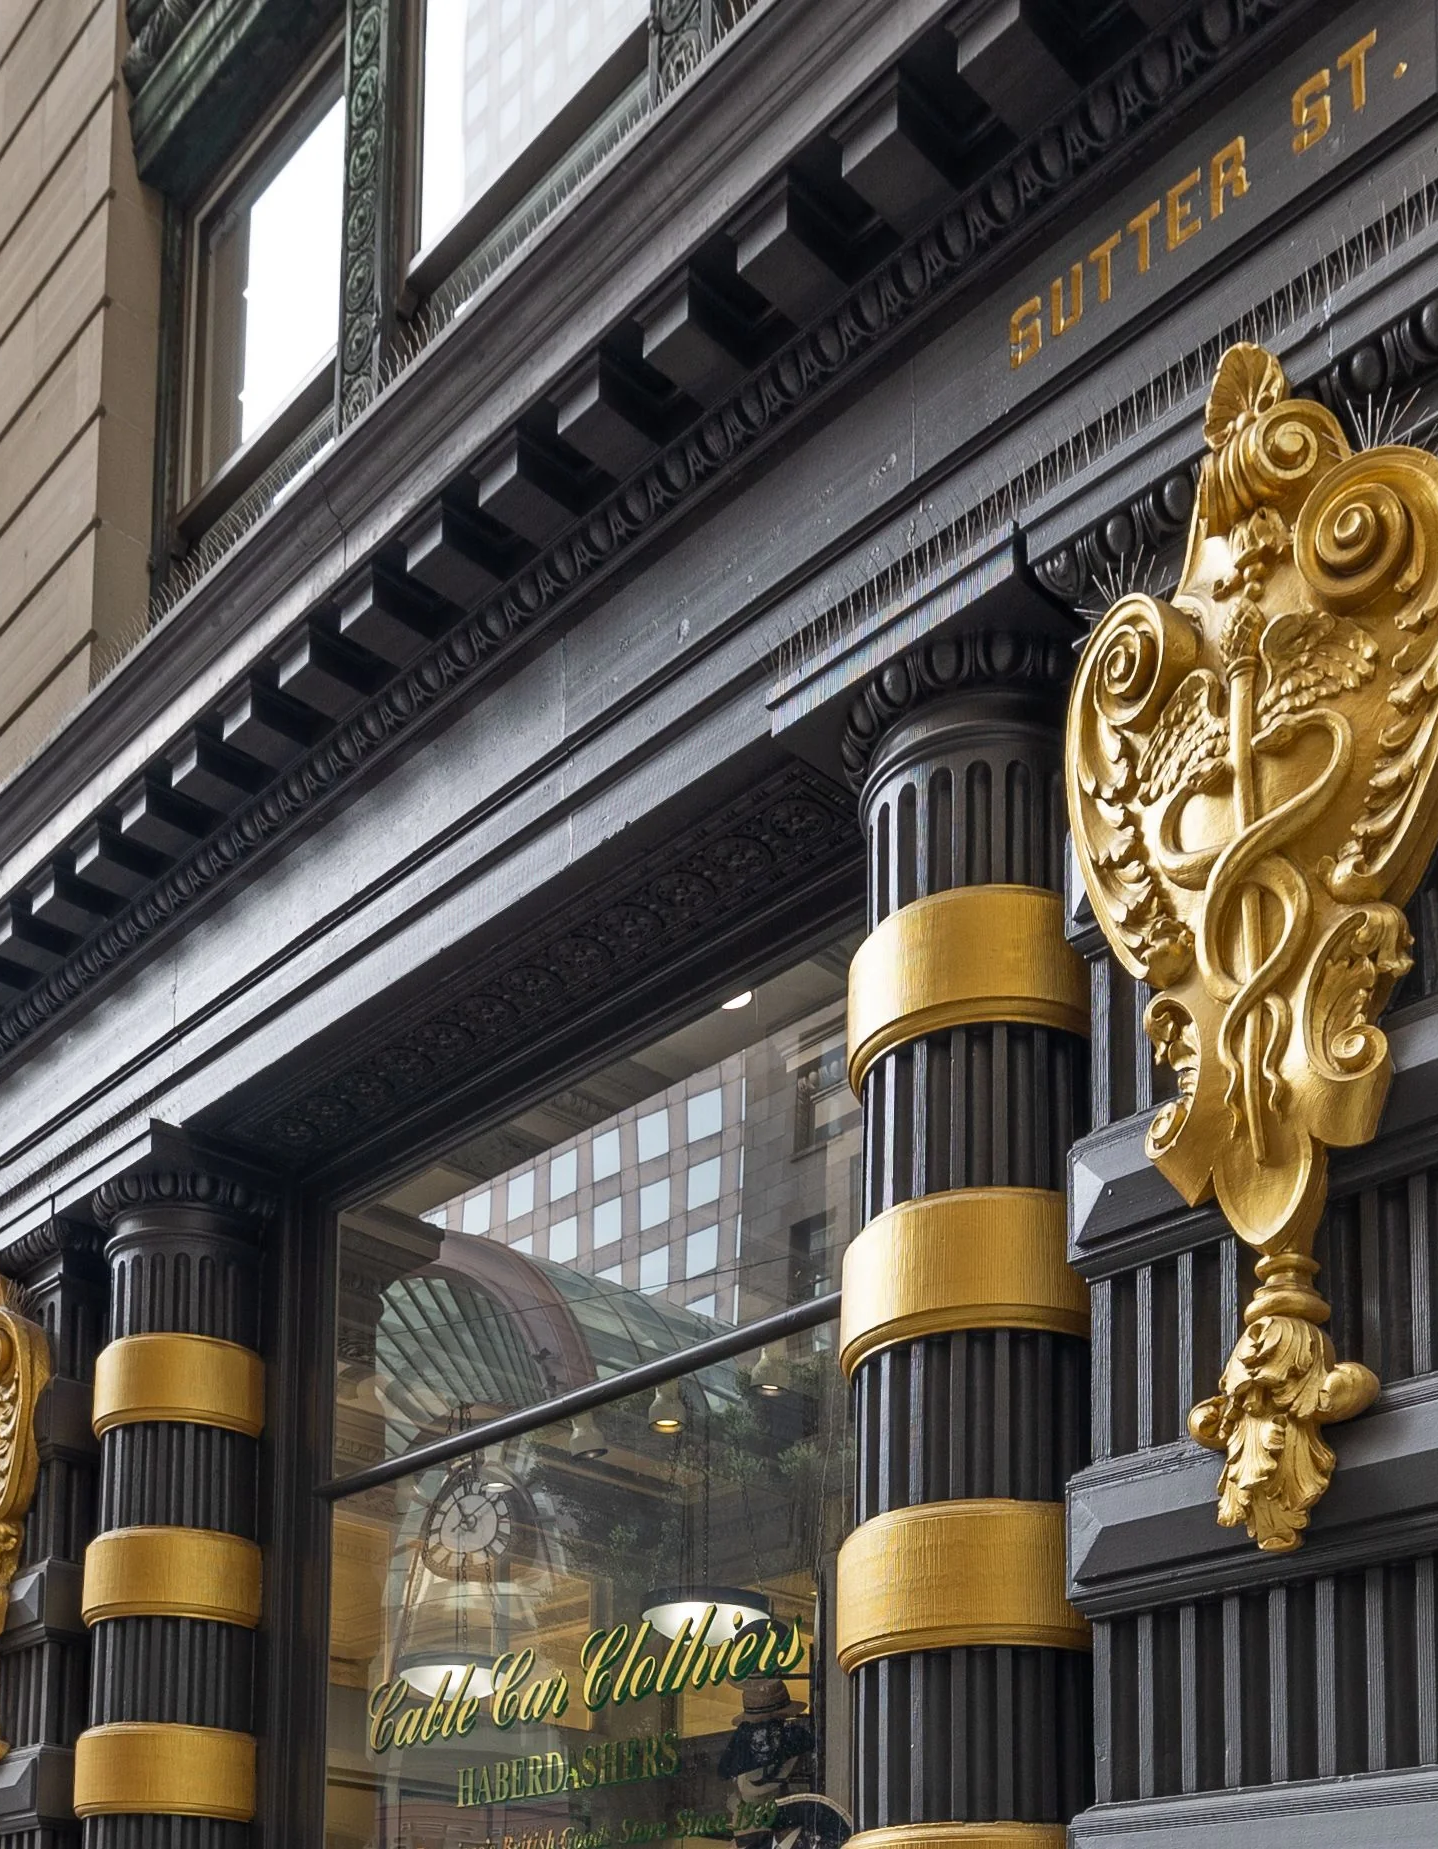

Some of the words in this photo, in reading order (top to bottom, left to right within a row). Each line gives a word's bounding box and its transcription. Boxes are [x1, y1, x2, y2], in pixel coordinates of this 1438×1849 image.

[1008, 135, 1252, 370] SUTTER
[1291, 28, 1409, 154] ST.
[368, 1663, 480, 1753] Cable
[491, 1646, 570, 1729] Car
[580, 1602, 805, 1711] Clothiers
[456, 1731, 682, 1809] HABERDASHERS
[674, 1807, 728, 1839] Since
